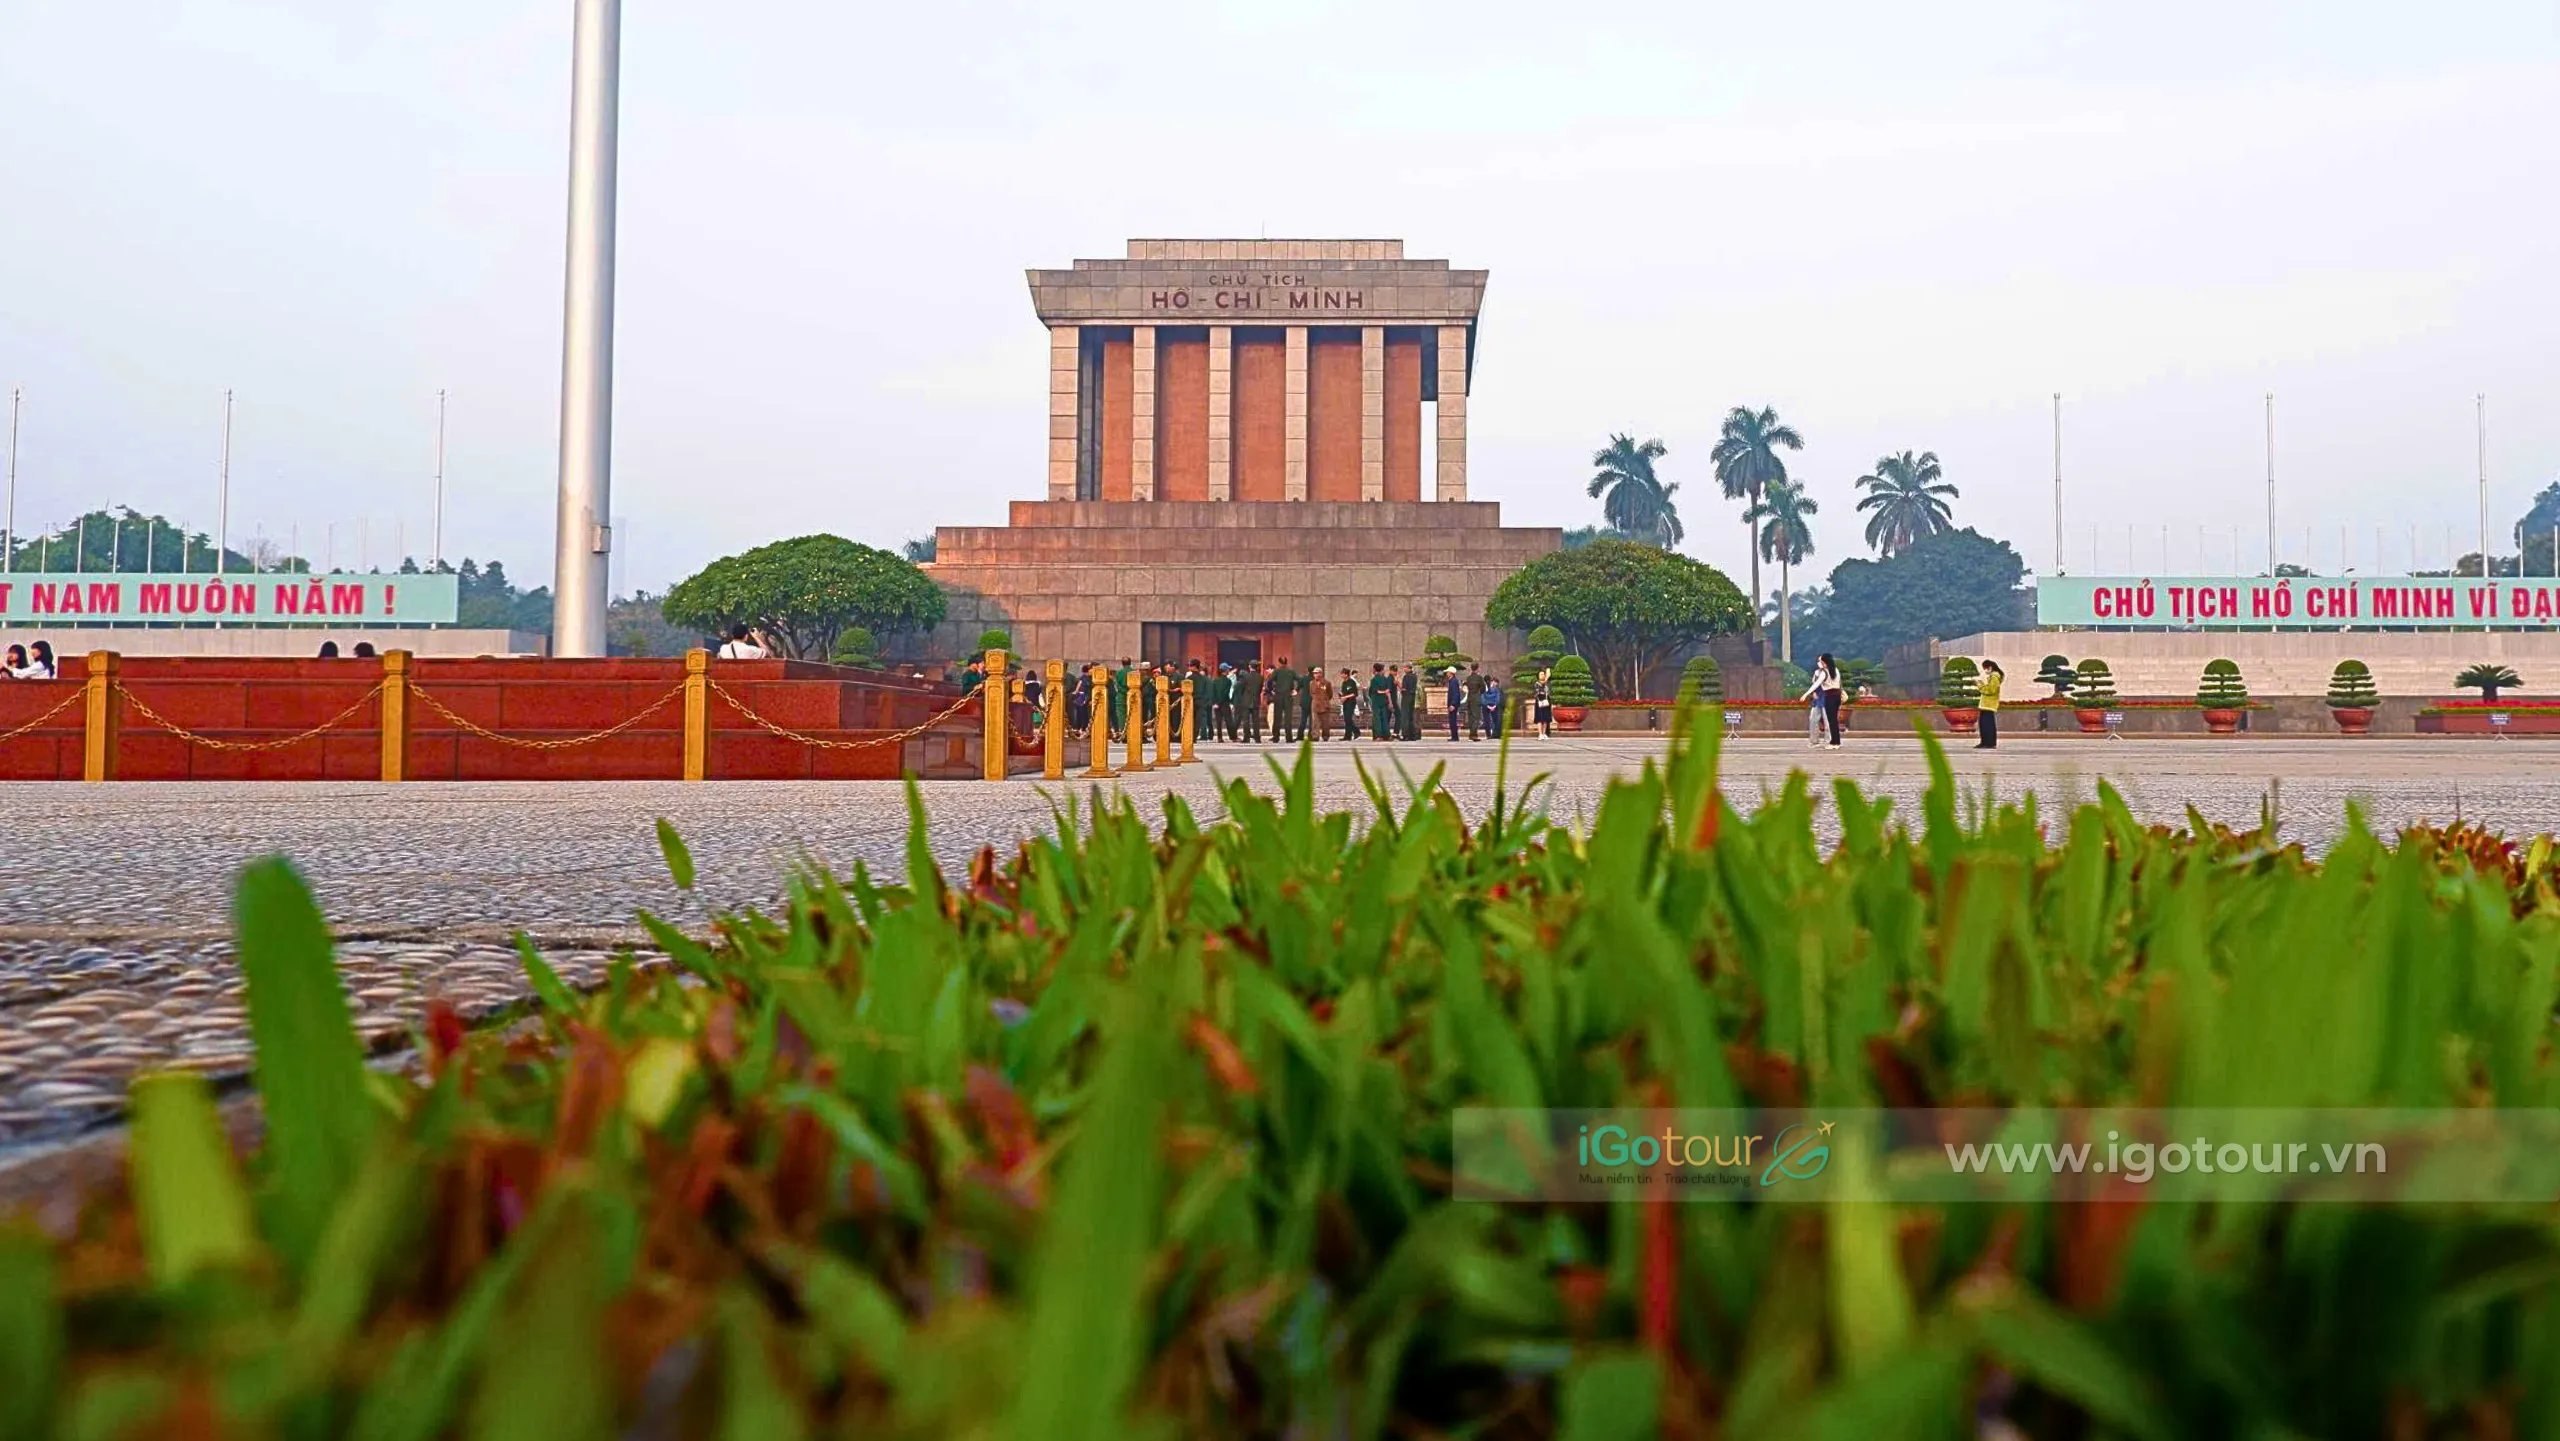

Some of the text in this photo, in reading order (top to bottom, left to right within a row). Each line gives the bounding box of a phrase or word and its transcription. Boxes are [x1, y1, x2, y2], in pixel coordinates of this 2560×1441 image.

[32, 583, 120, 614] NAM
[140, 578, 257, 614] MUÔN
[274, 578, 365, 615] NĂM
[2093, 578, 2155, 617] CHỦ
[2168, 587, 2238, 623] TỊCH
[2252, 578, 2292, 617] HỒ
[2306, 581, 2358, 617] CHÍ
[2372, 587, 2454, 617] MINH
[2468, 582, 2498, 618] VĨ
